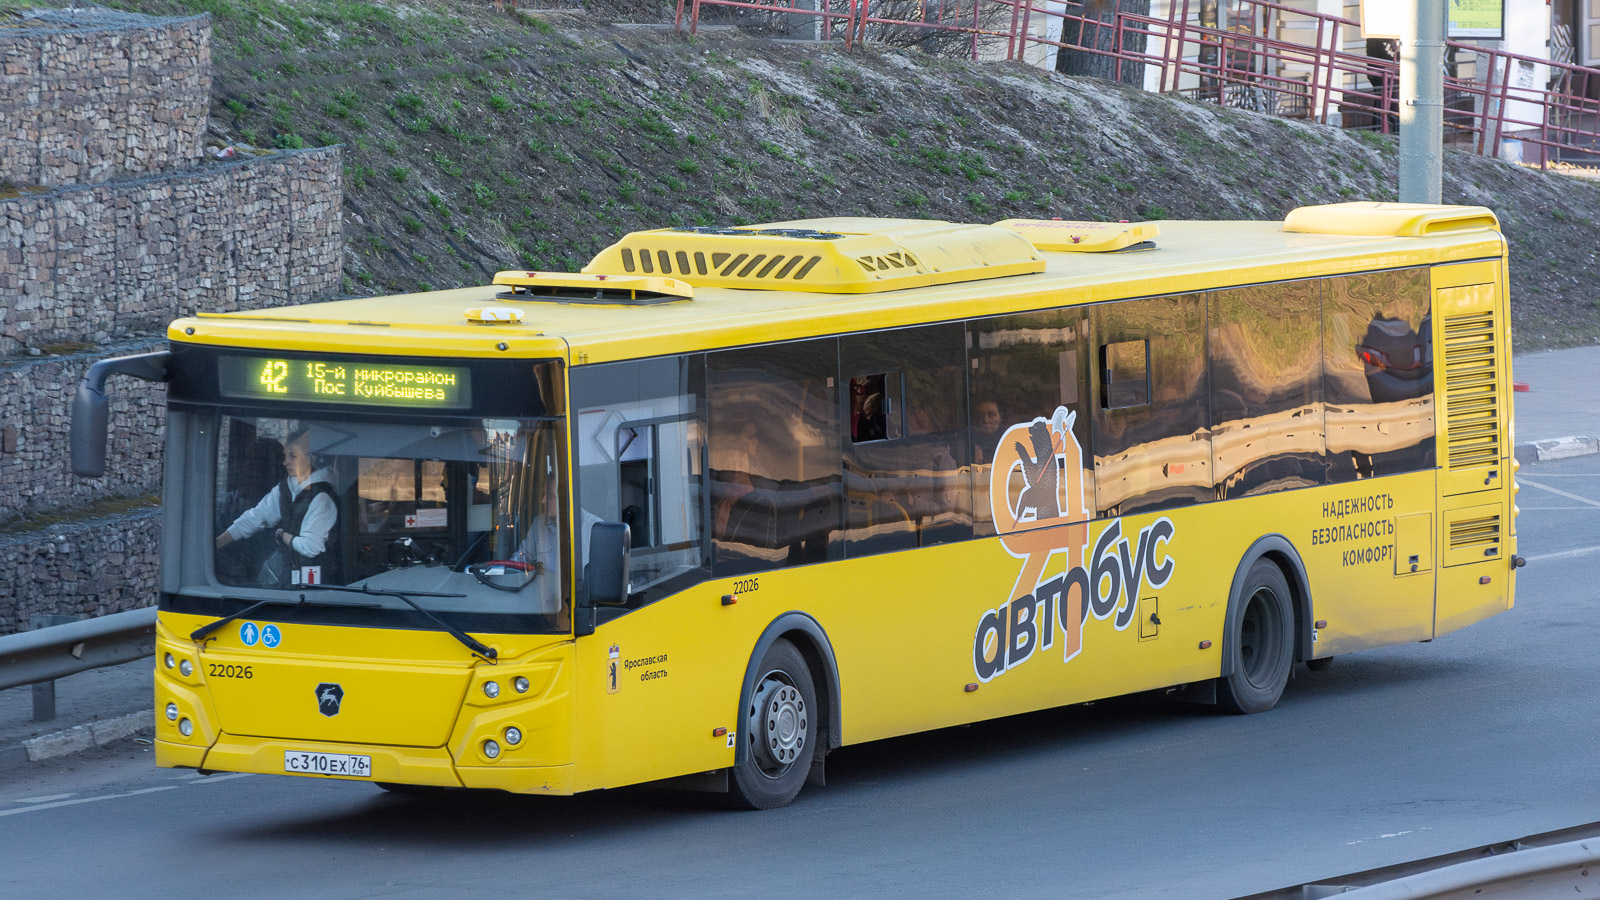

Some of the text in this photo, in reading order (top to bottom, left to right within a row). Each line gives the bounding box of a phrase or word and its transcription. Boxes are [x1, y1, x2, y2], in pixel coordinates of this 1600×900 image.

[260, 360, 288, 393] 42
[306, 362, 456, 386] 15-й микрорайон
[314, 378, 446, 400] Пос Куйбышева
[1321, 493, 1394, 519] НАДЕЖНОСТЬ
[1311, 519, 1394, 546] БЕЗОПАСНОСТЬ
[1342, 544, 1394, 567] КОМФОРТ
[733, 578, 759, 594] 22026
[974, 518, 1174, 681] автобус
[209, 663, 253, 679] 22026
[624, 653, 668, 671] Ярославская
[640, 670, 668, 682] область
[350, 757, 365, 769] 76
